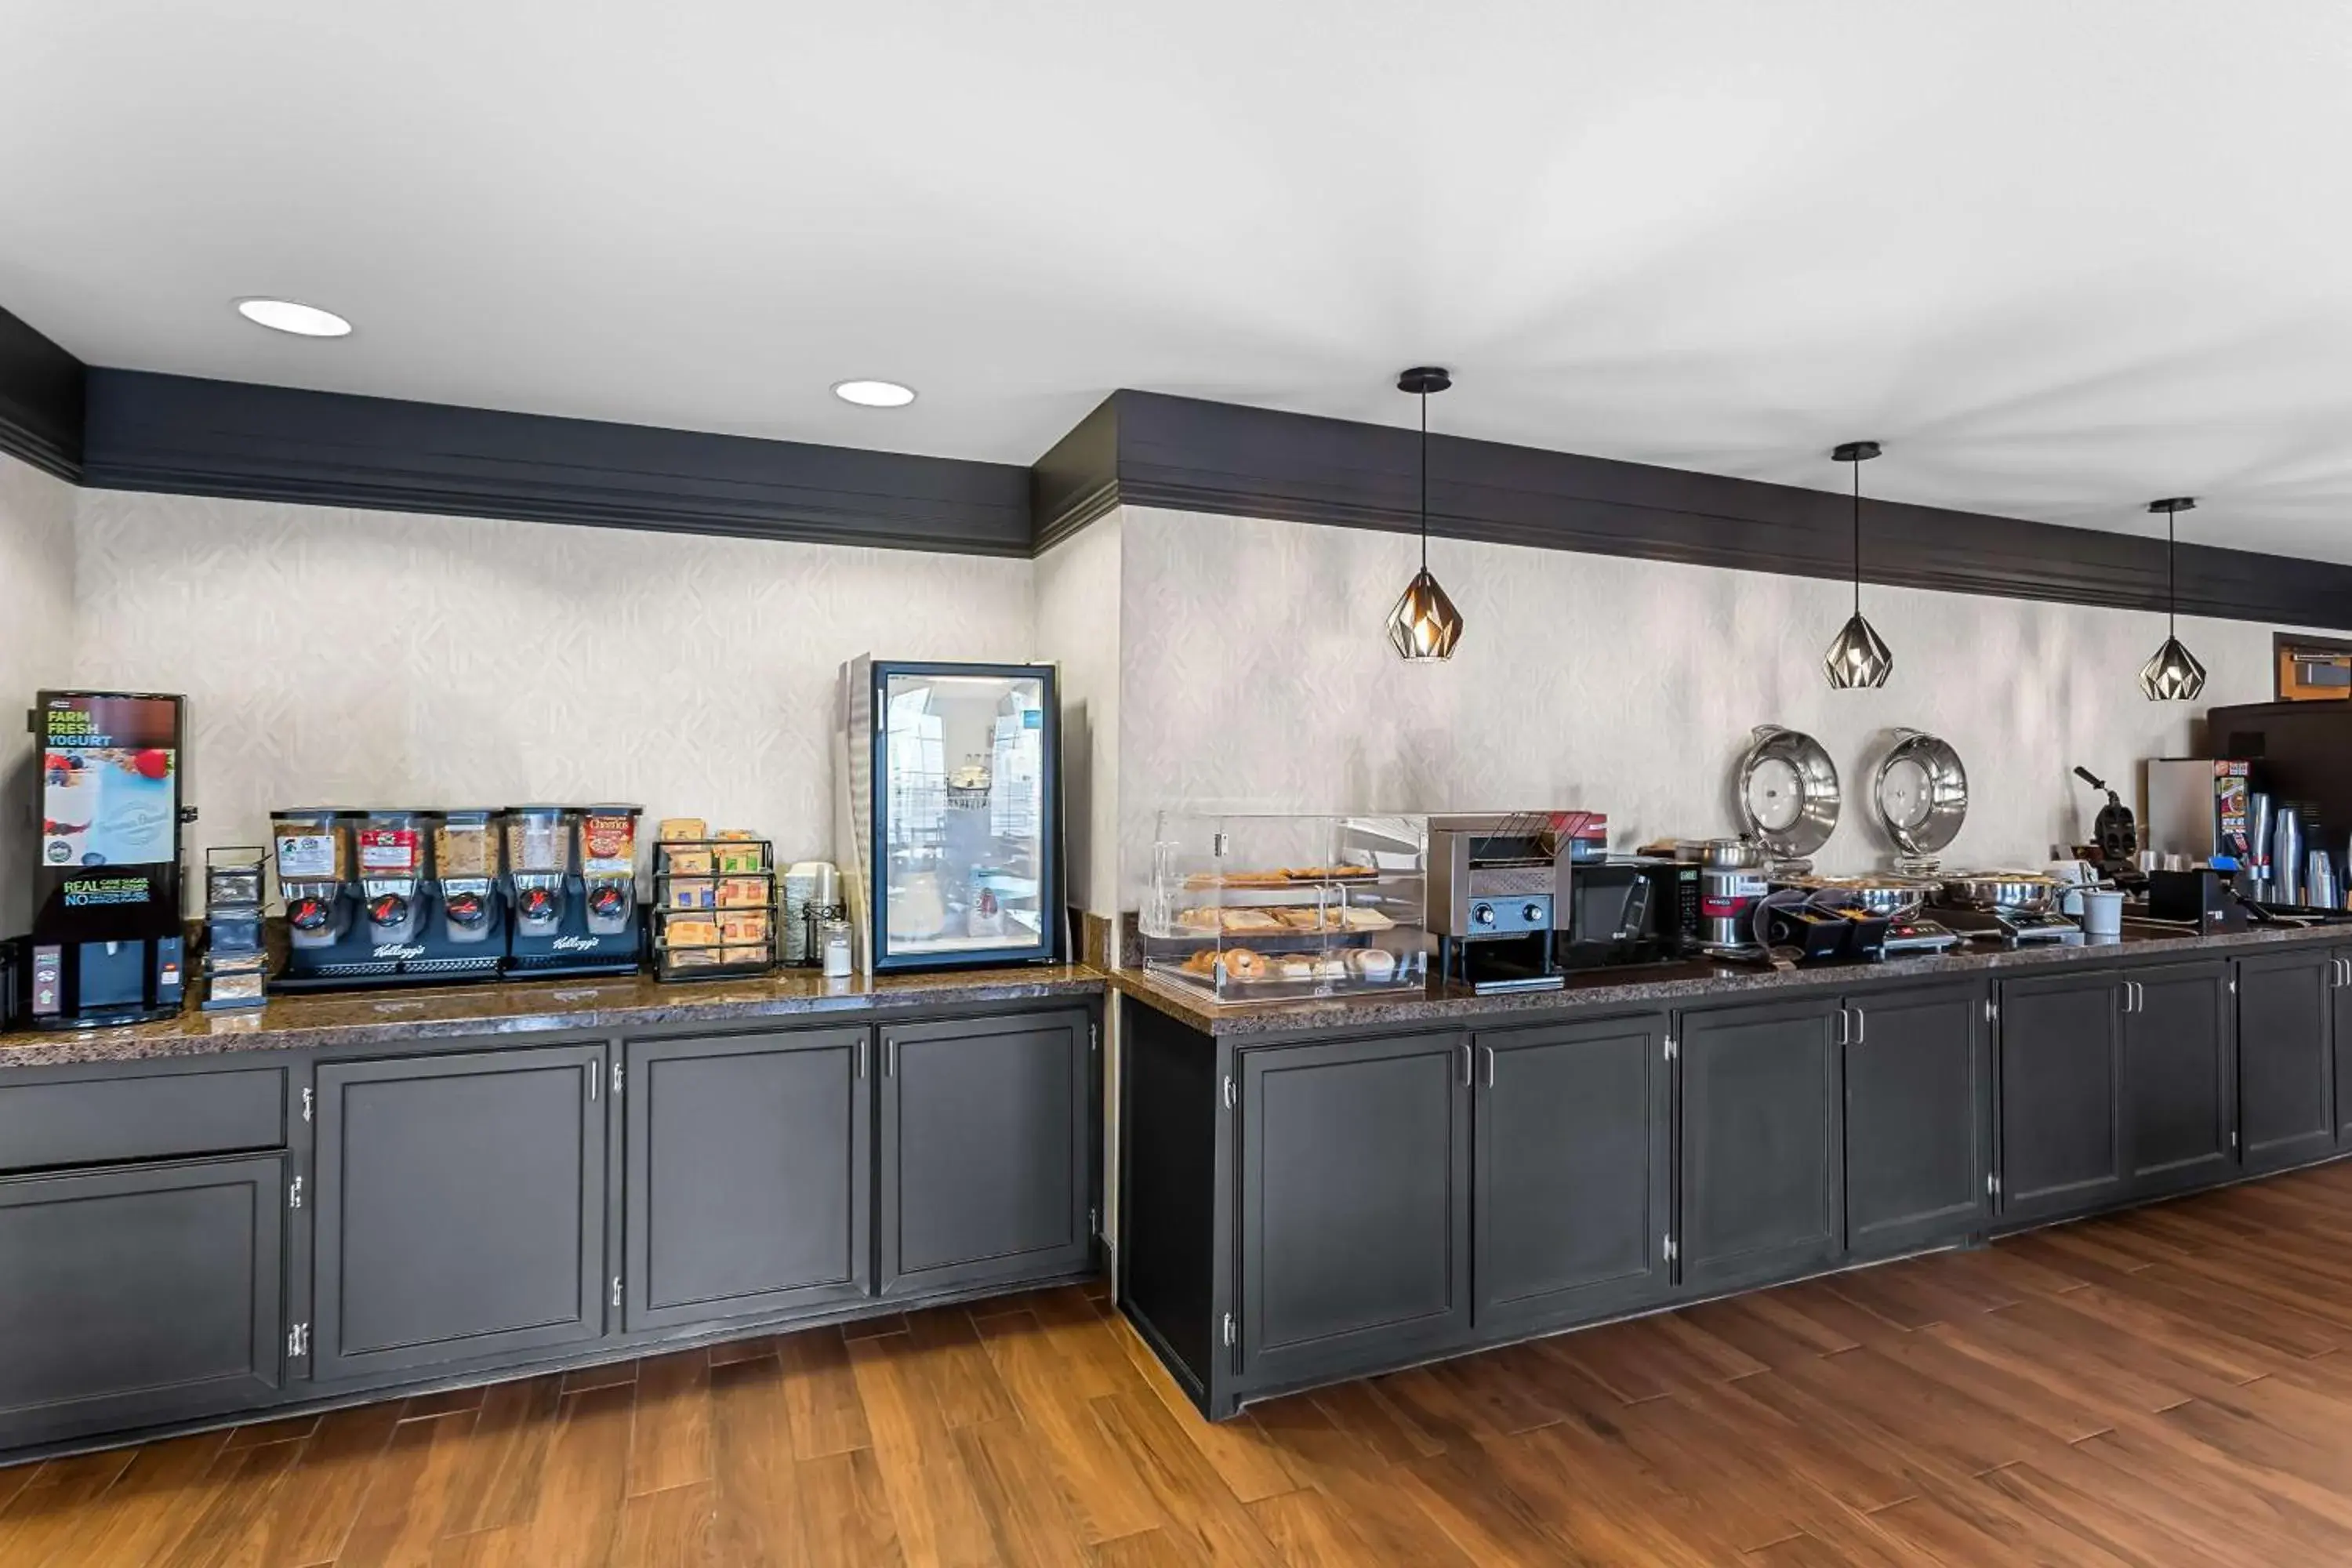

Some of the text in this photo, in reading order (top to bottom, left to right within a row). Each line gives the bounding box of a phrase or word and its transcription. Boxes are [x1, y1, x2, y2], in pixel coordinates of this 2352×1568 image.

[48, 711, 90, 722] FARM
[48, 723, 100, 734] FRESH
[48, 735, 113, 746] YOGURT
[64, 880, 100, 893] REAL
[65, 895, 88, 906] NO
[551, 936, 600, 951] Kellogg's
[373, 943, 426, 959] Kellogg's
